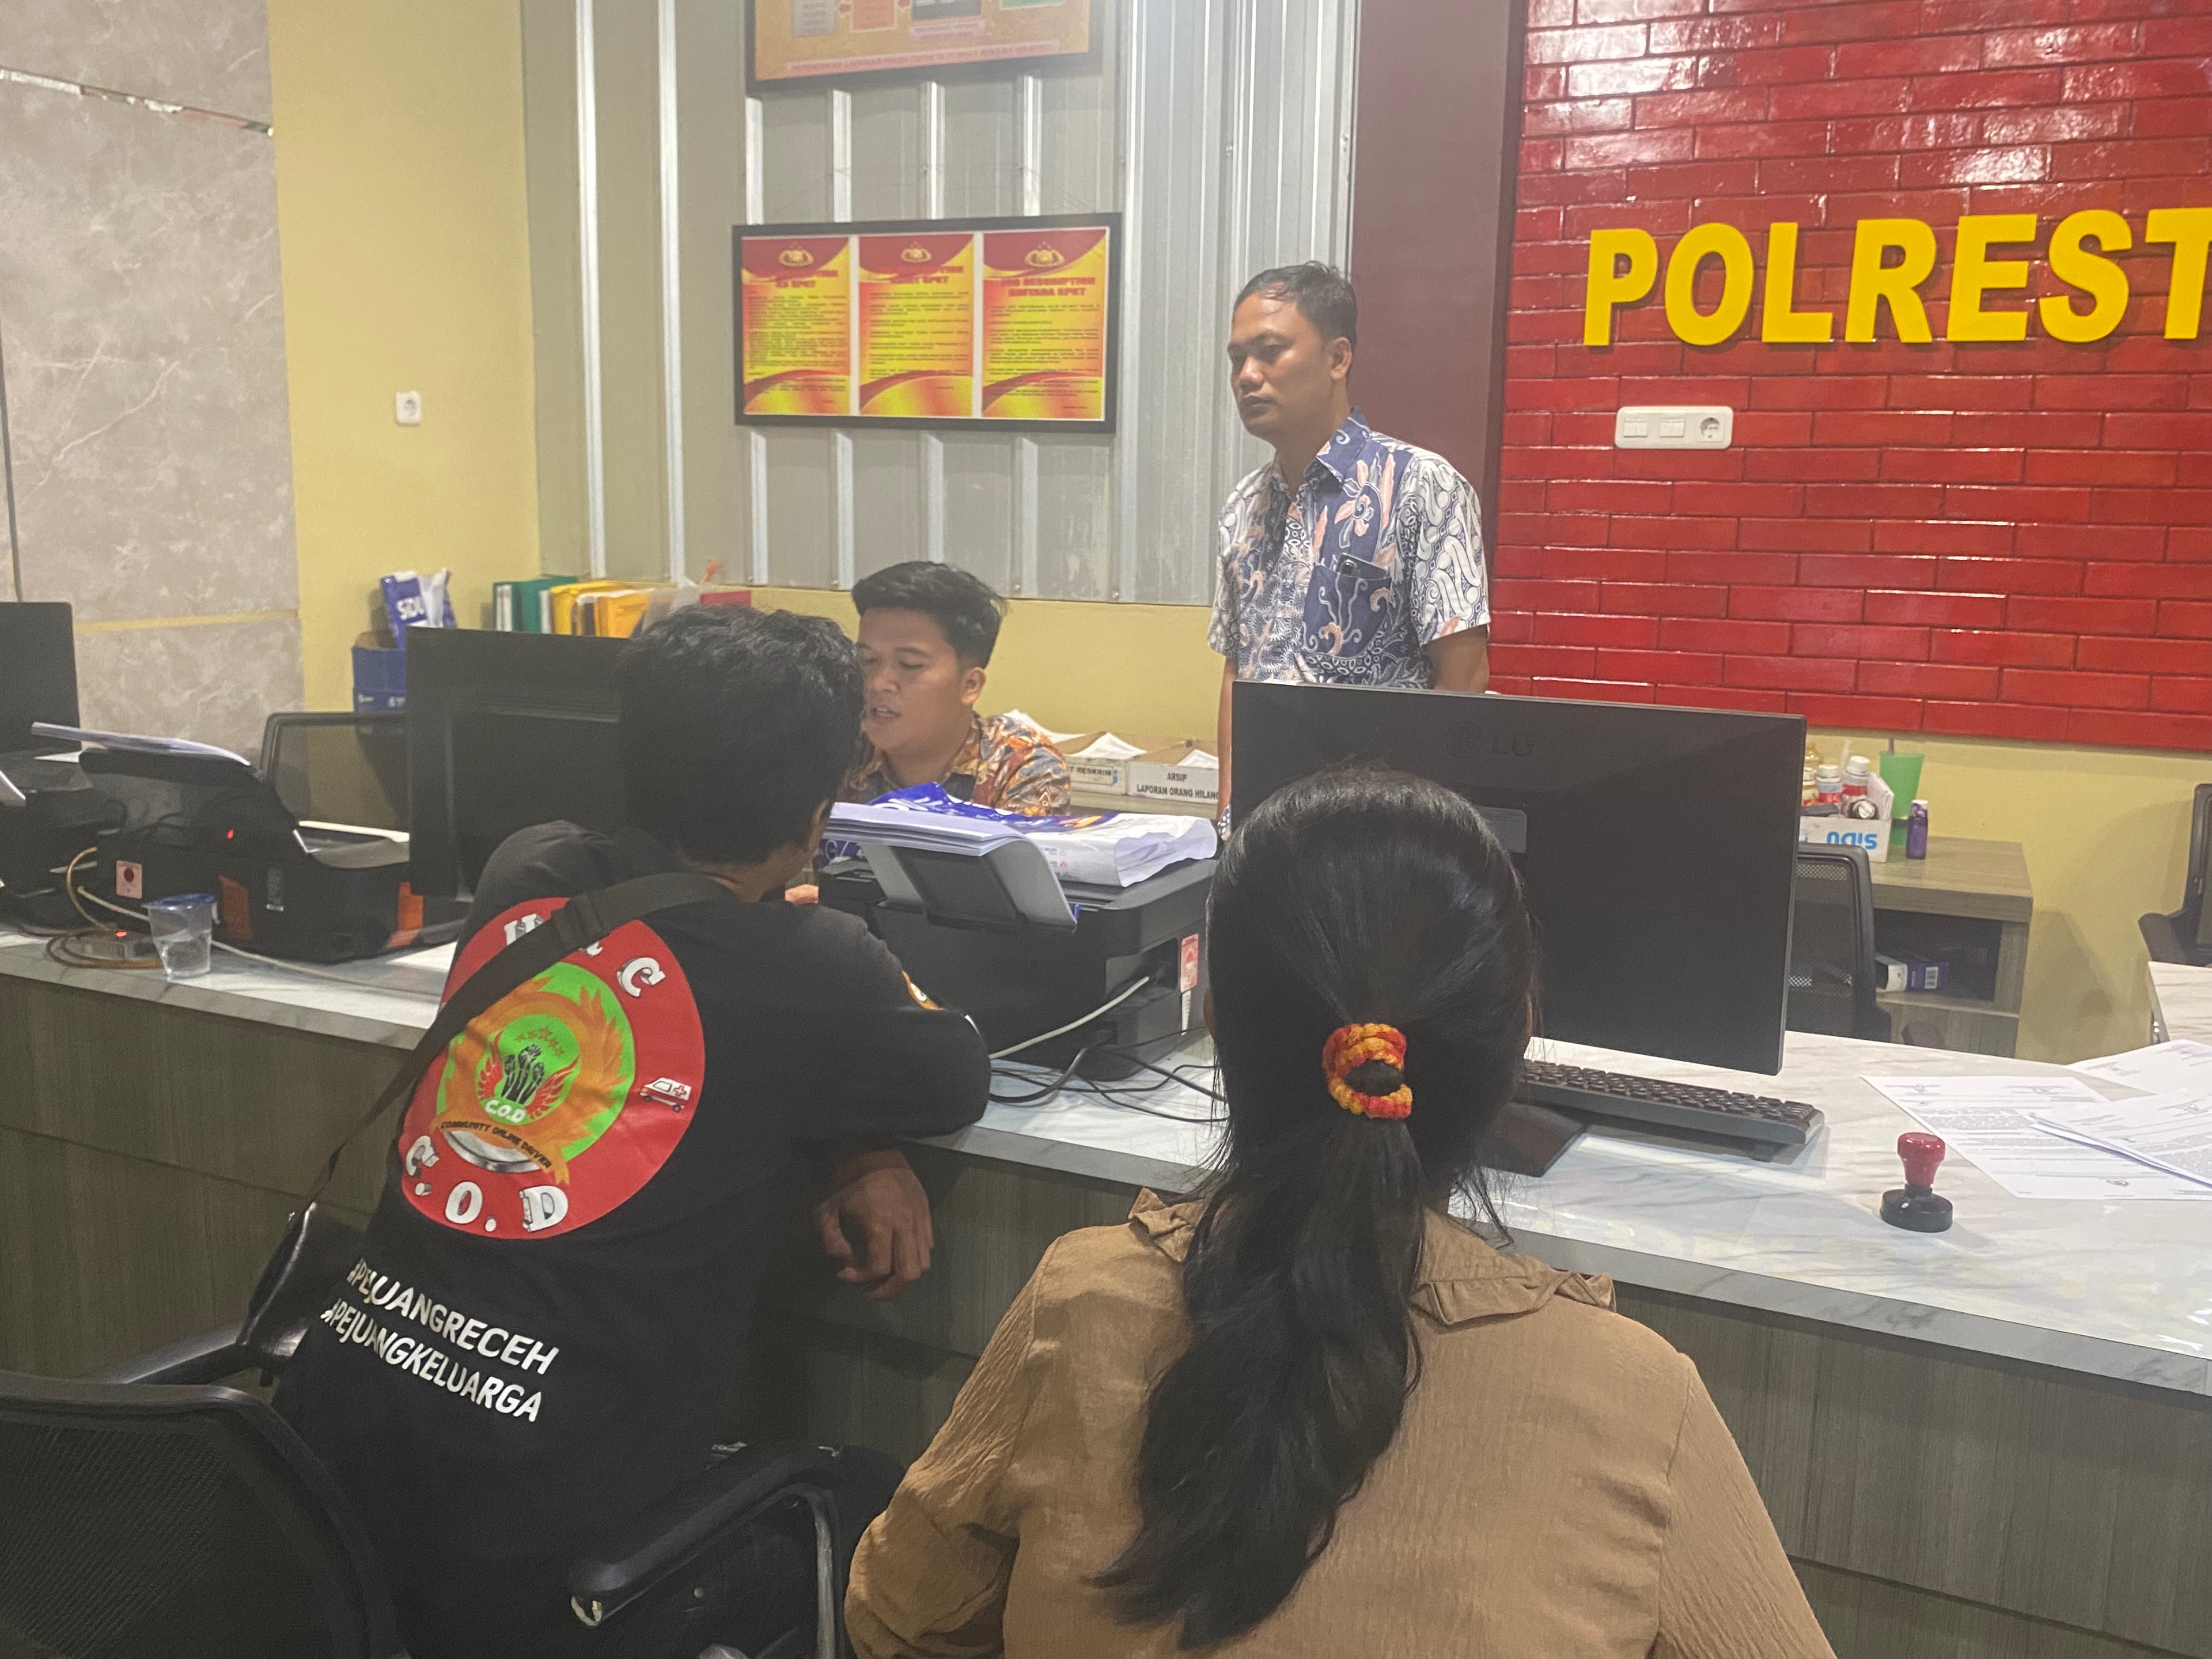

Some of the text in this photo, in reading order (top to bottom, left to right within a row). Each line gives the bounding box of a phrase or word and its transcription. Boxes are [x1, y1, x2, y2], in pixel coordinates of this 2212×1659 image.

[1584, 209, 2212, 346] POLREST
[1076, 767, 1112, 777] RESKRIM
[1166, 772, 1187, 782] ARSIP
[1137, 784, 1168, 795] LAPORAN
[1169, 787, 1193, 798] ORANG
